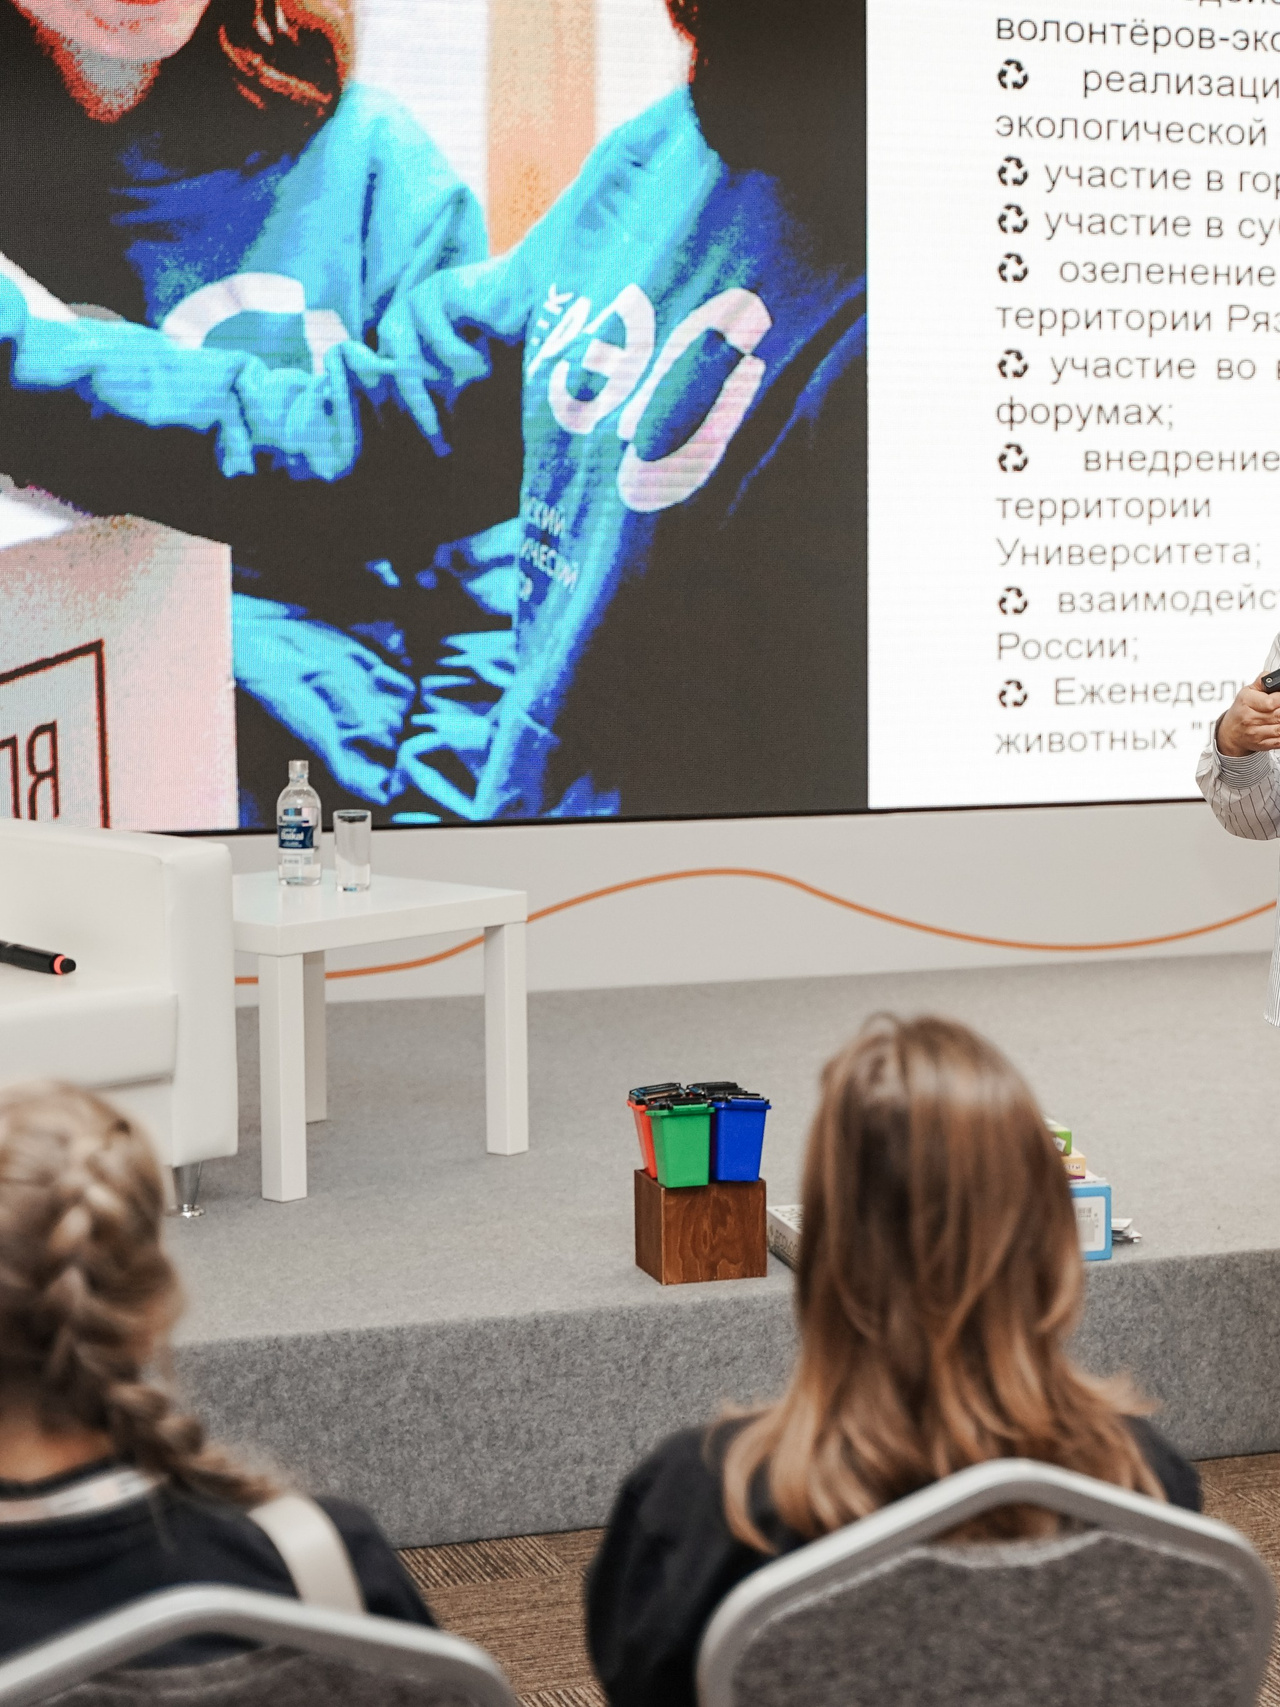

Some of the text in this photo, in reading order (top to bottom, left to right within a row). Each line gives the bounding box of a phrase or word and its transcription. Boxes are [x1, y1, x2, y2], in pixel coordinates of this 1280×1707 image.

[996, 115, 1266, 146] экологической
[1044, 164, 1191, 193] участие
[1207, 170, 1224, 191] в
[1044, 212, 1191, 241] участие
[1207, 217, 1223, 238] в
[1059, 261, 1276, 287] озеленение
[996, 307, 1211, 338] территории
[1050, 357, 1196, 385] участие
[1217, 358, 1257, 380] во
[995, 395, 1172, 432] форумах;
[1084, 450, 1280, 478] внедрение
[996, 497, 1210, 527] территории
[996, 538, 1260, 572] Университета;
[997, 632, 1137, 662] России;
[996, 729, 1177, 754] животных
